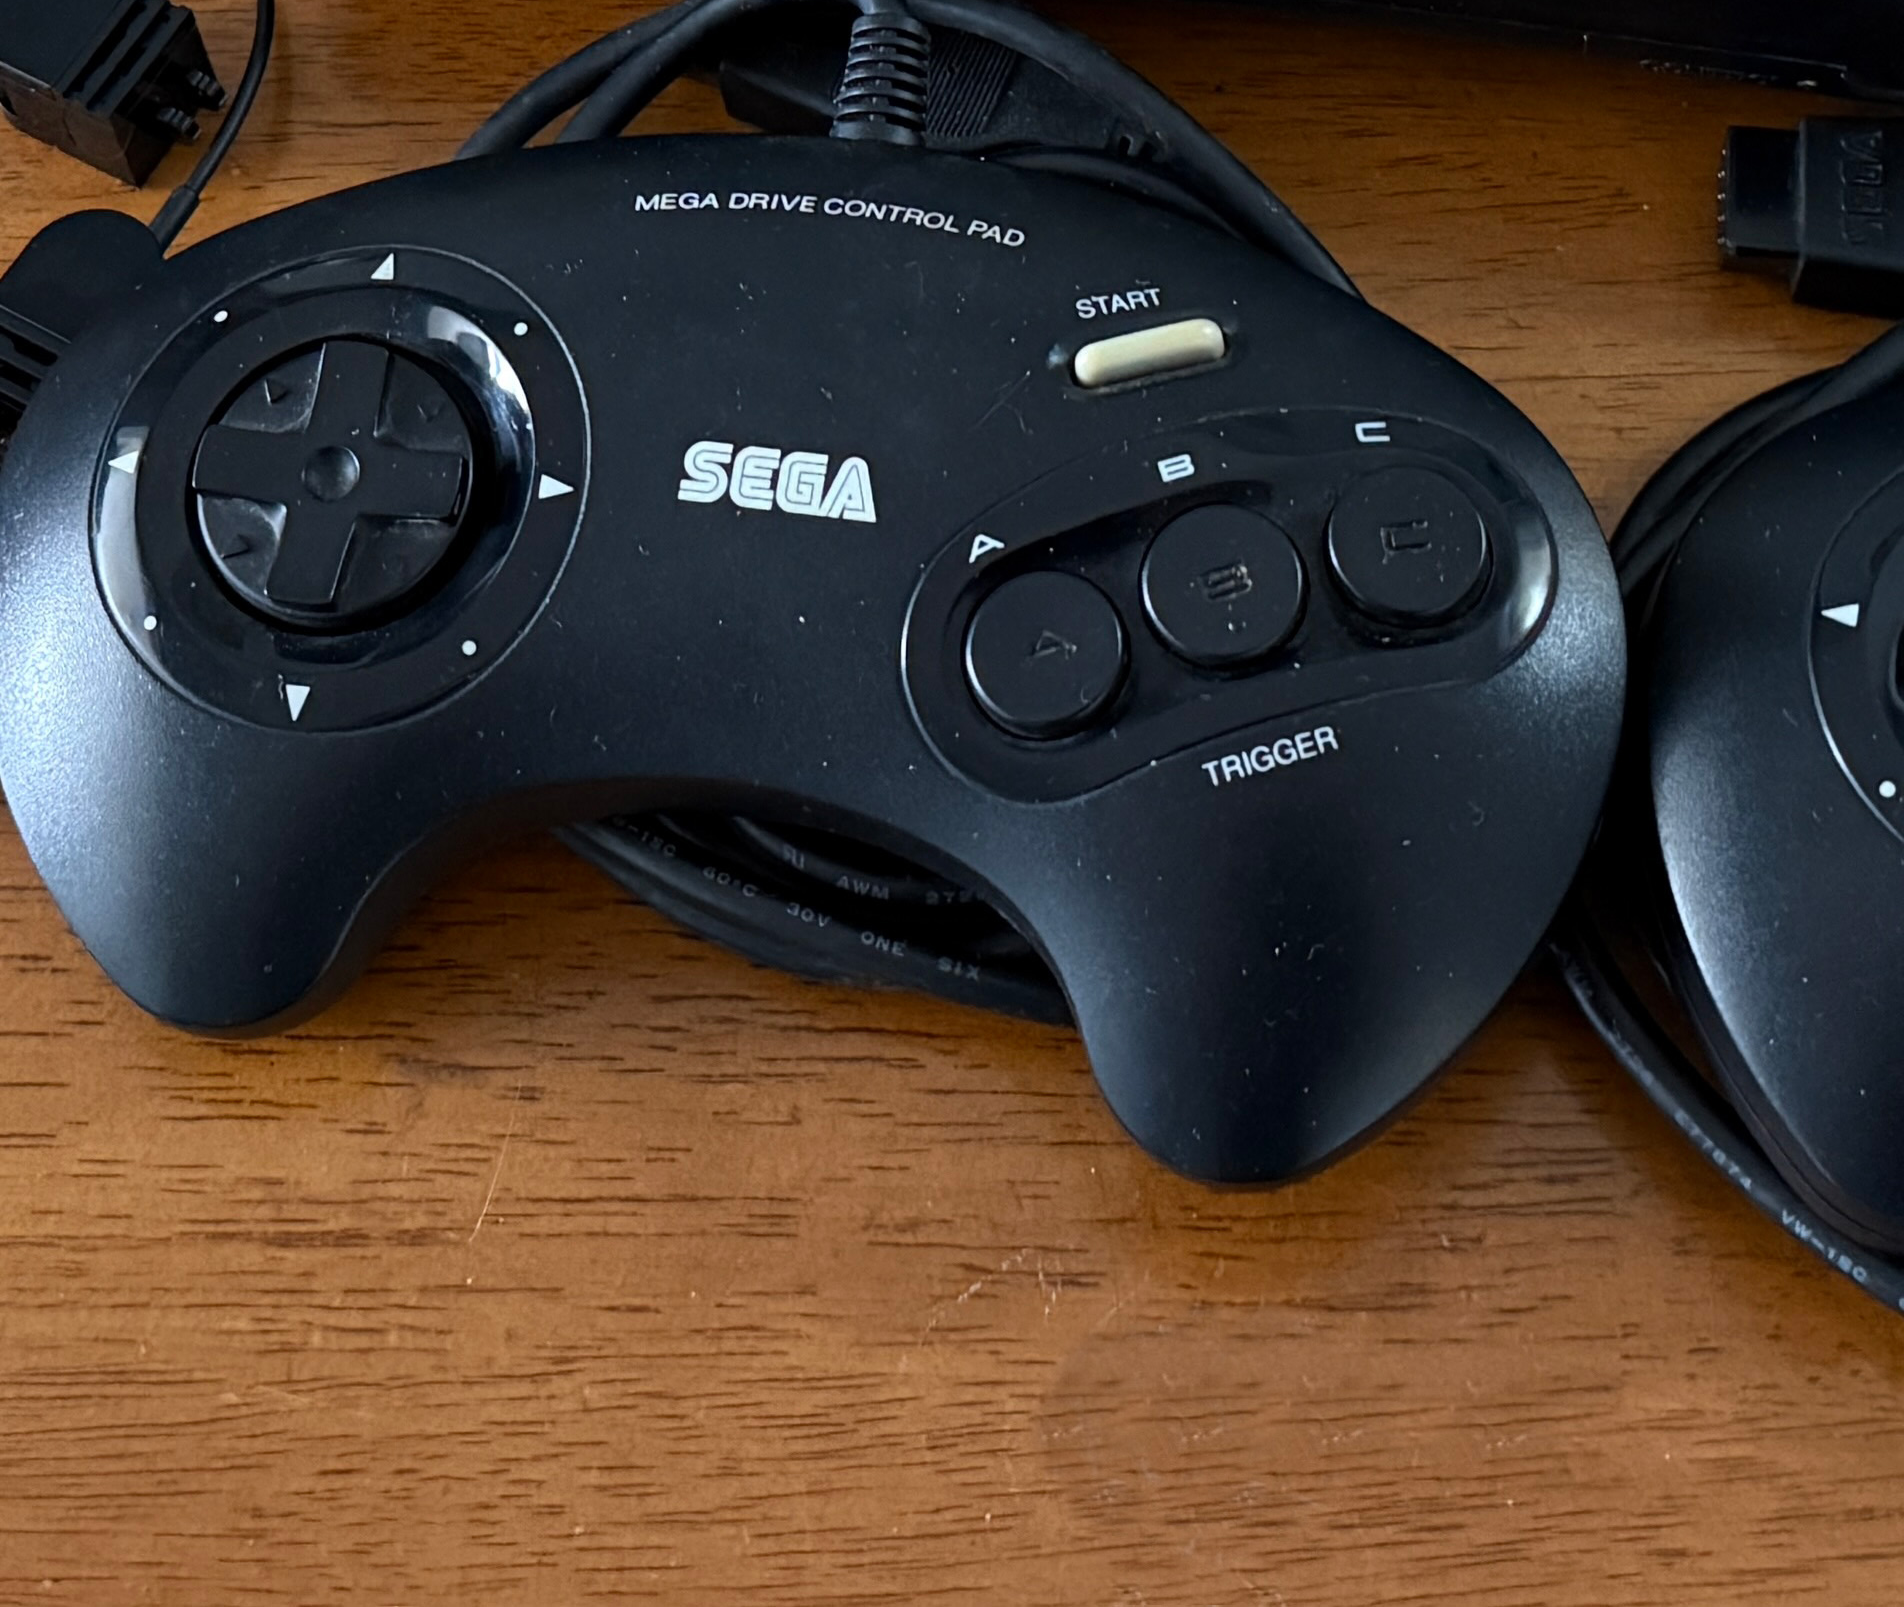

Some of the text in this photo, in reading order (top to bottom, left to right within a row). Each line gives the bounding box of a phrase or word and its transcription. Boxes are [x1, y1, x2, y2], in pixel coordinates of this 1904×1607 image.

[635, 193, 1026, 248] MEGA DRIVE CONTROL PAD
[1075, 286, 1163, 320] START
[1356, 421, 1390, 443] C
[678, 441, 877, 523] SEGA
[1158, 454, 1195, 482] B
[969, 534, 1005, 563] A
[1201, 725, 1340, 787] TRIGGER
[786, 902, 832, 928] 30V
[860, 930, 905, 957] ONE
